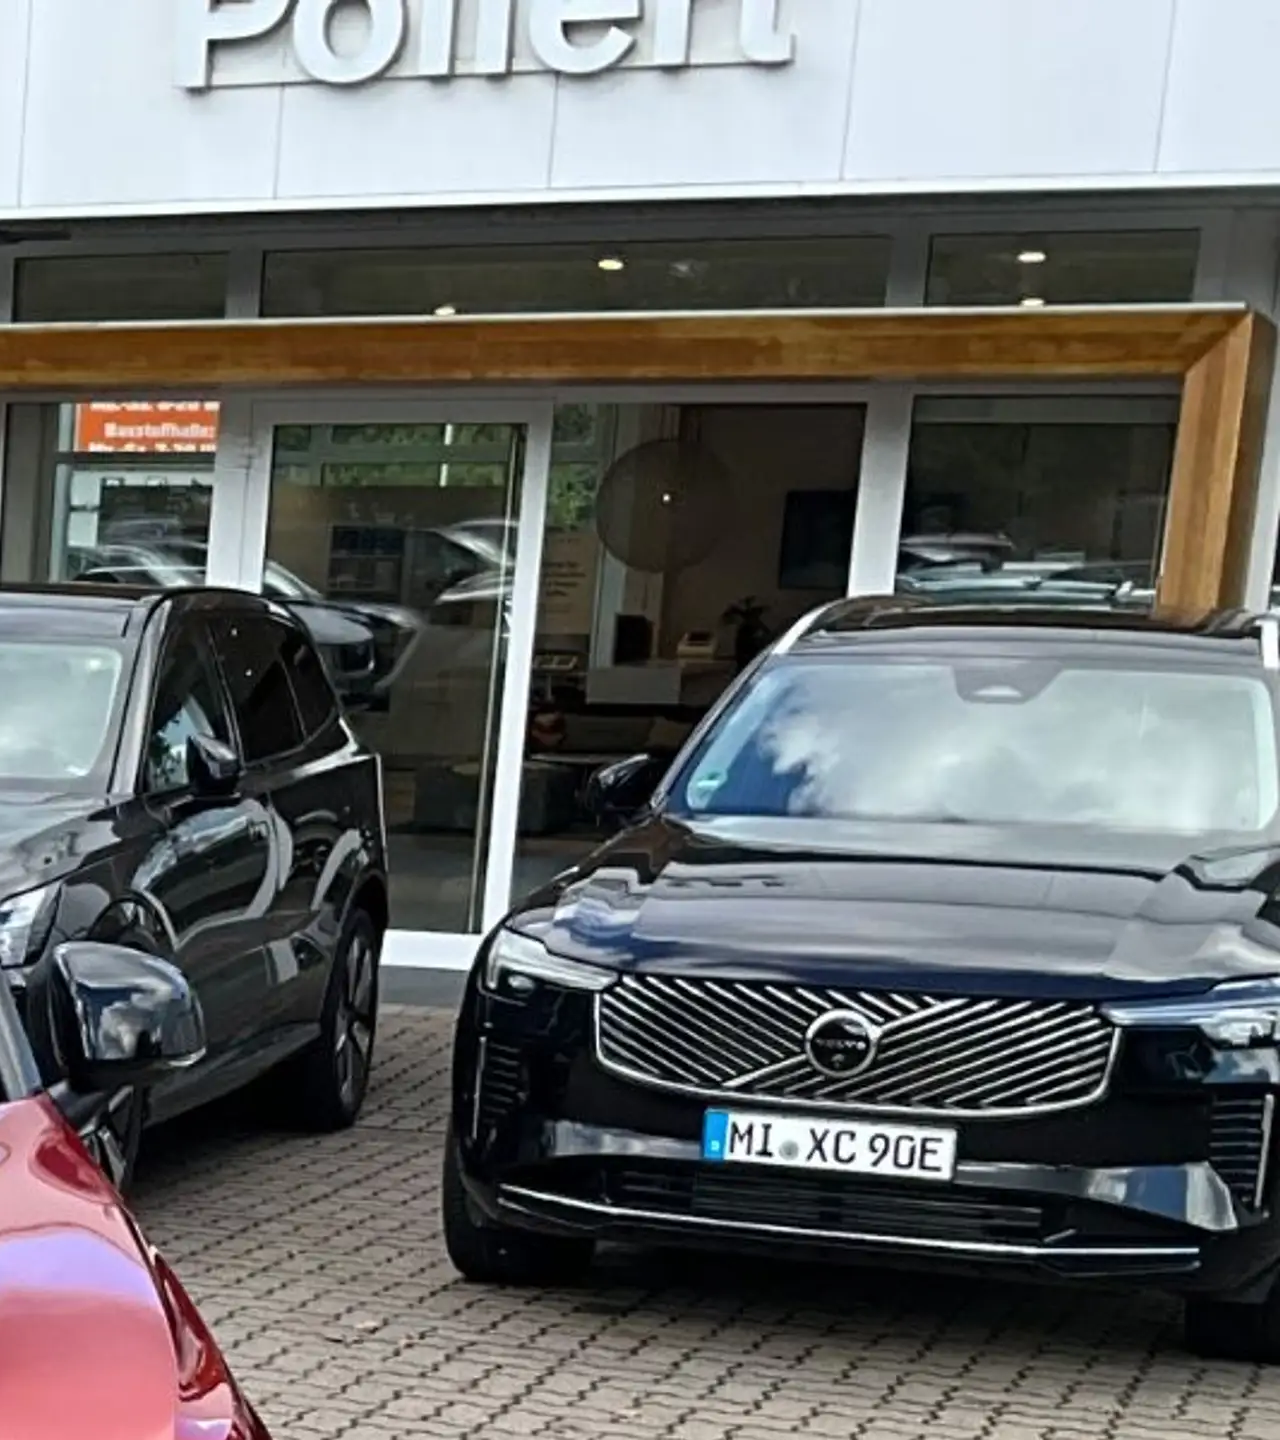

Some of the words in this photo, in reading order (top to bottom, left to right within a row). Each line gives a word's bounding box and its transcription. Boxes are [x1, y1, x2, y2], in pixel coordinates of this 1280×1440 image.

[729, 1121, 774, 1158] MI
[806, 1127, 857, 1165] XC
[869, 1132, 944, 1173] 90E
